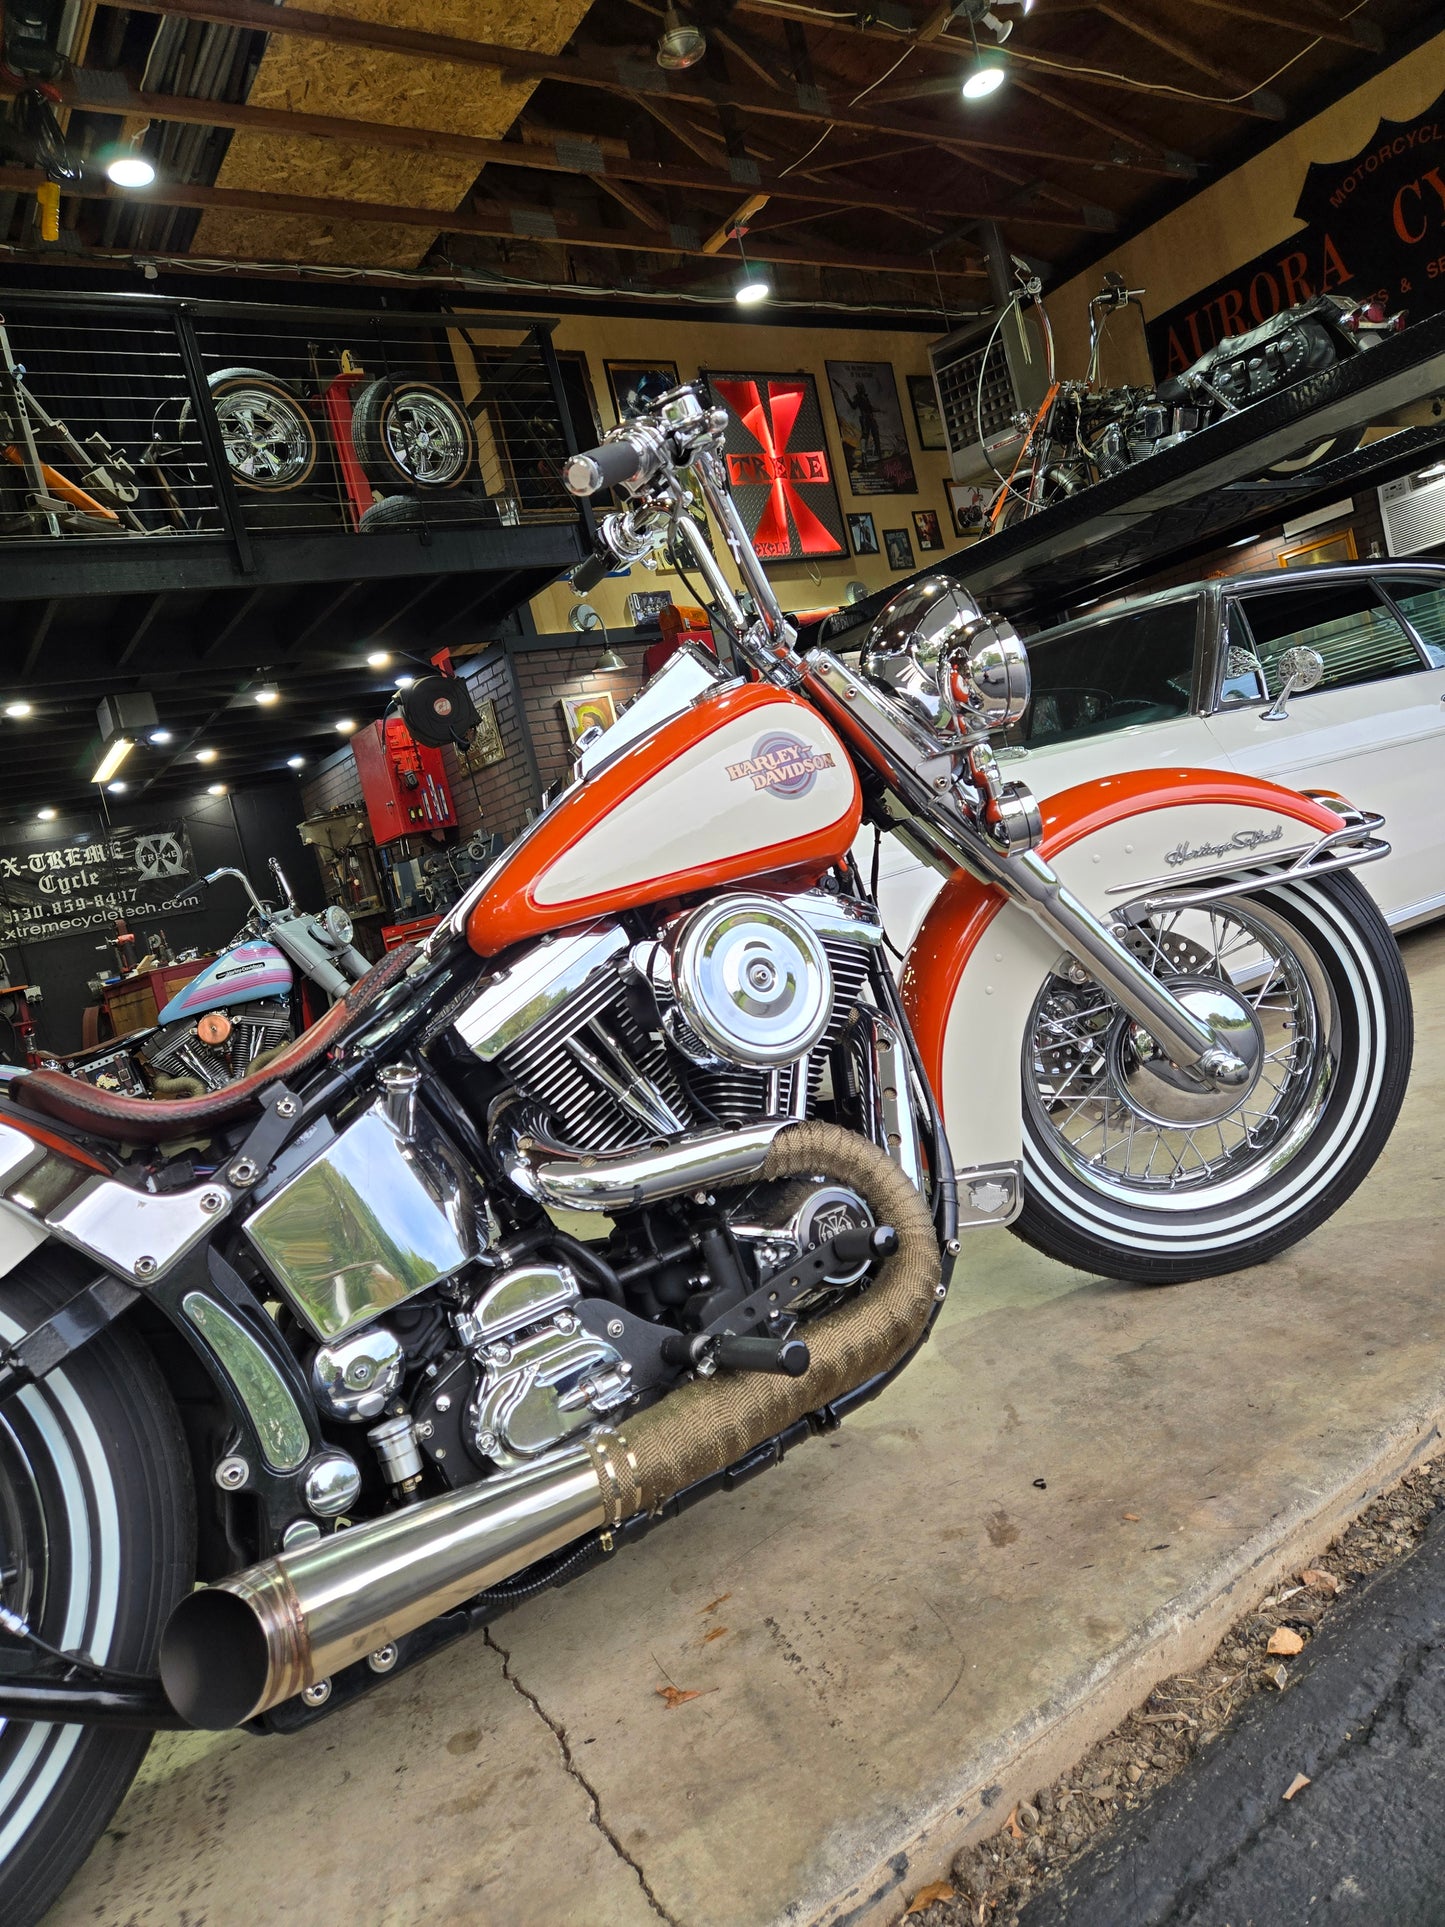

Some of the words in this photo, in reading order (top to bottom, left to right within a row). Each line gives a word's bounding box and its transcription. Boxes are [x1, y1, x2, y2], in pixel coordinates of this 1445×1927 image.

[1329, 123, 1445, 209] MOTORCYCL
[1400, 277, 1413, 293] &
[1165, 232, 1355, 380] AURORA
[730, 455, 824, 482] TREME
[725, 745, 812, 781] HARLEY-
[750, 753, 836, 791] DAVIDSON
[1, 841, 125, 879] X-TREME
[140, 850, 178, 863] TREME
[38, 869, 101, 895] Cycle
